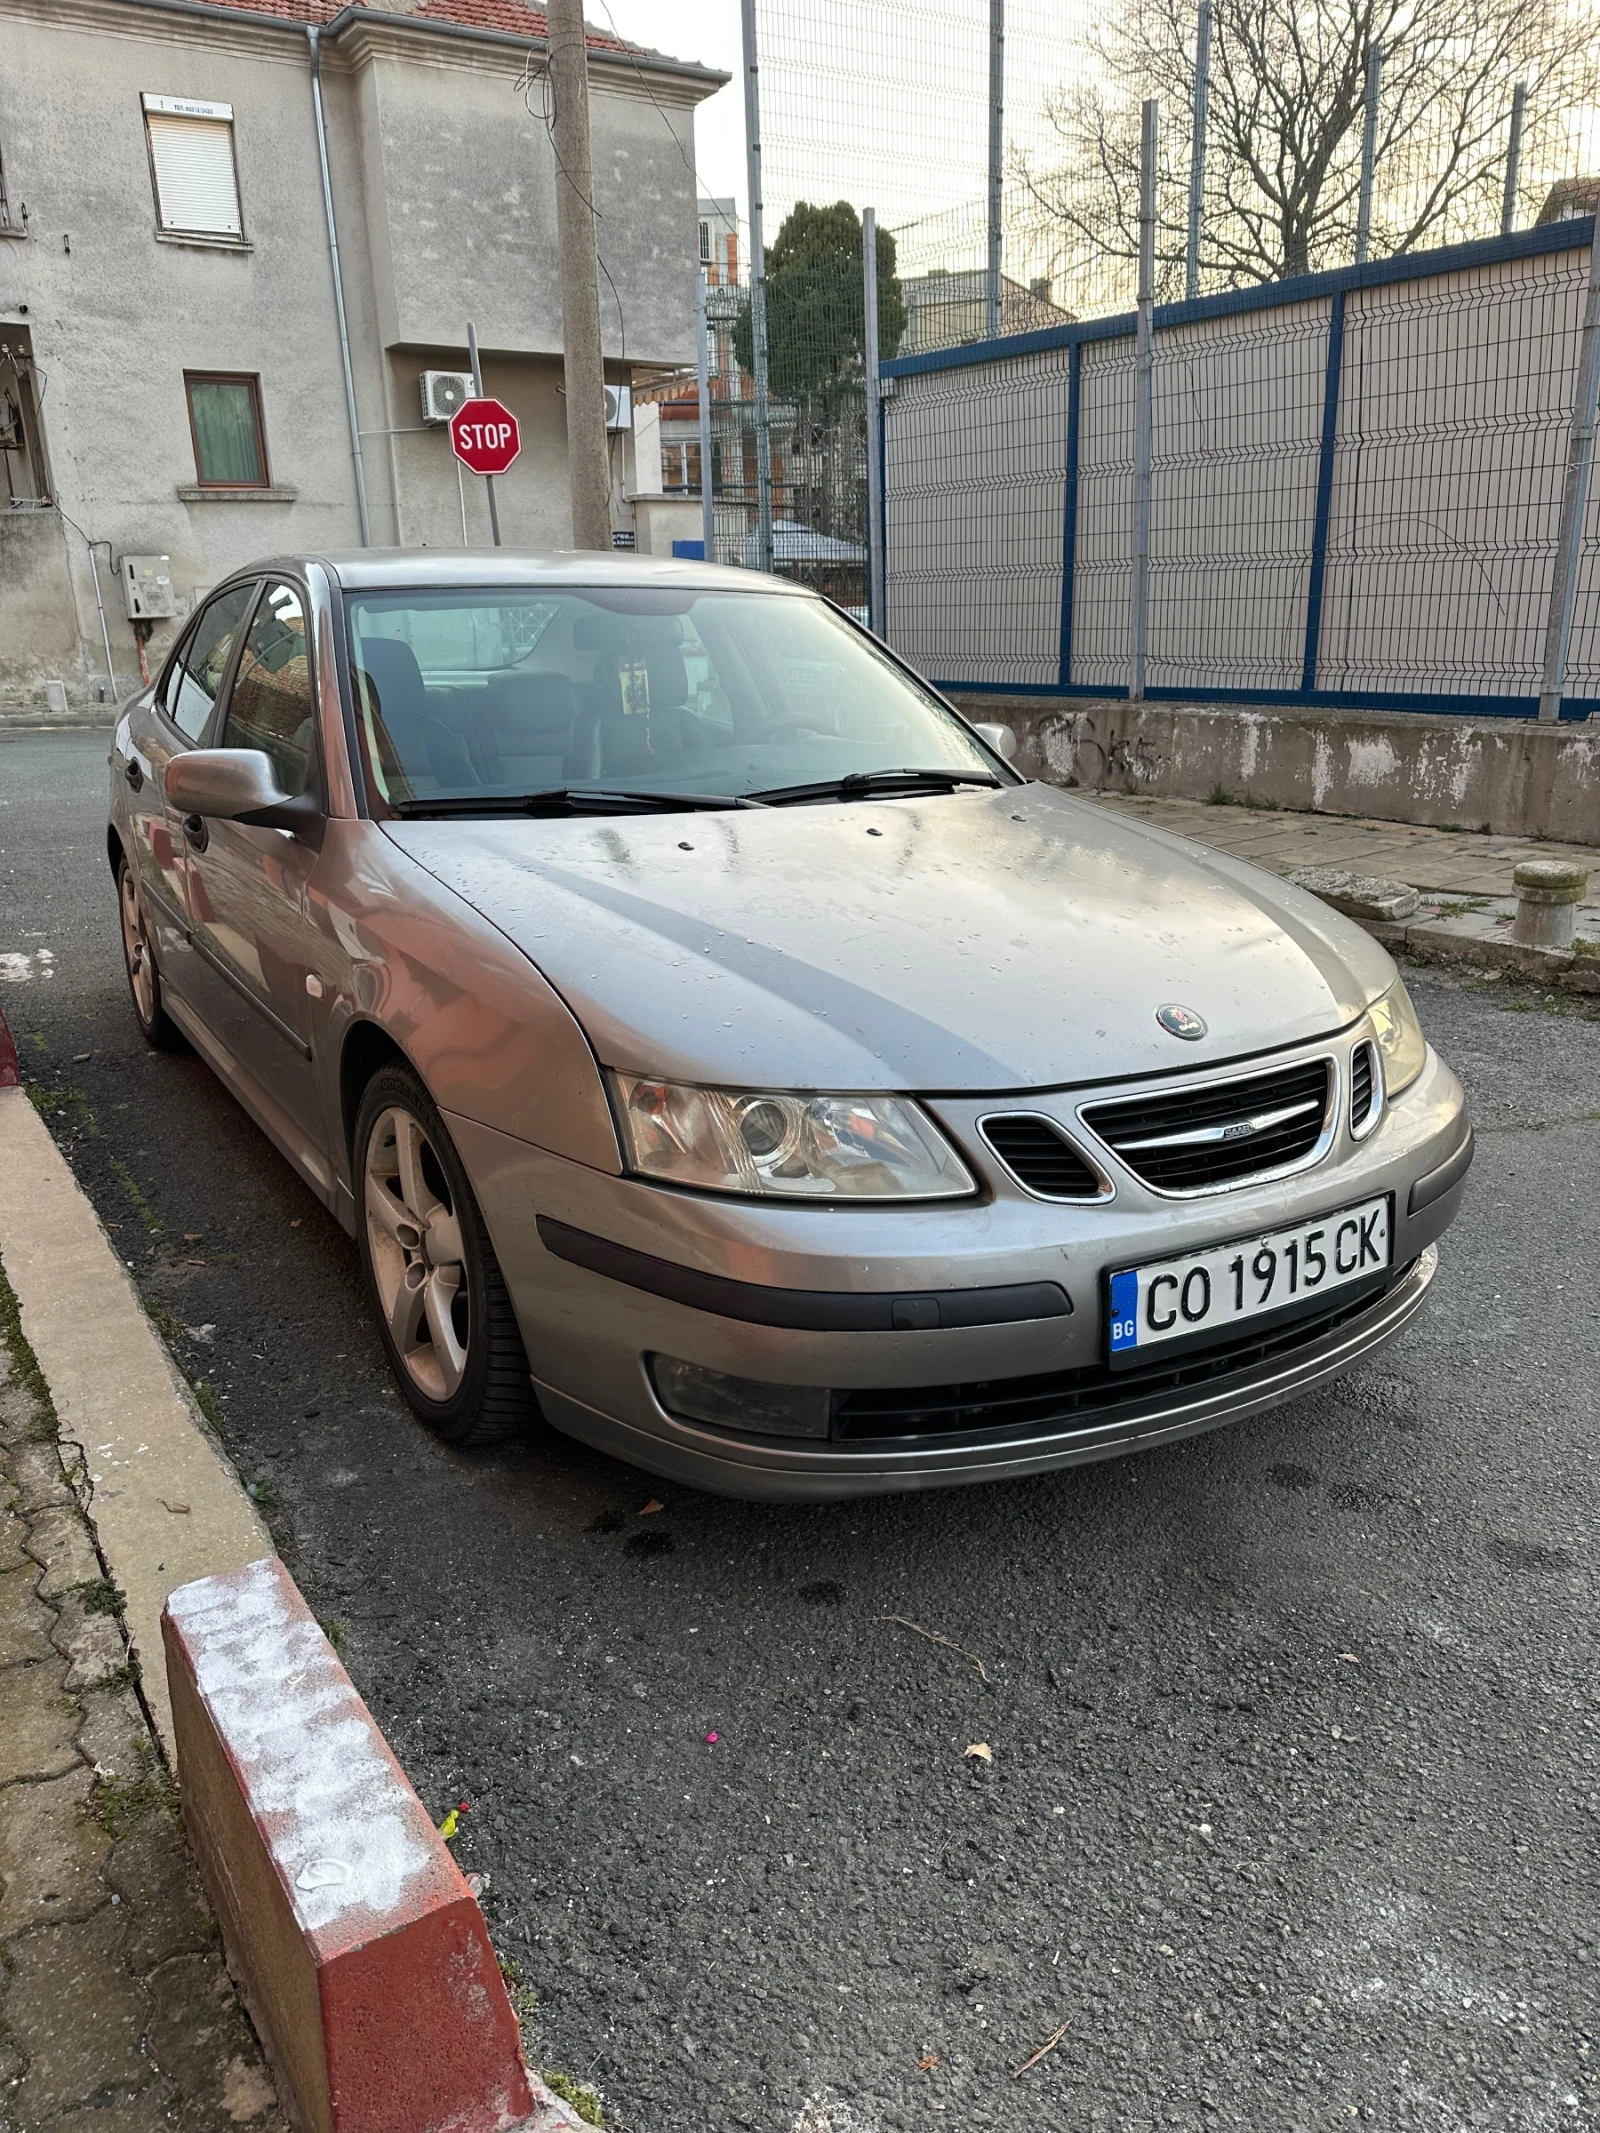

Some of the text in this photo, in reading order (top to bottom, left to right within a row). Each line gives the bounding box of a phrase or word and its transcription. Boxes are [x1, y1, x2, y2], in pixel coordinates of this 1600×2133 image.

[459, 423, 511, 449] STOP
[1223, 1124, 1251, 1139] SAAB
[1113, 1319, 1134, 1341] BG
